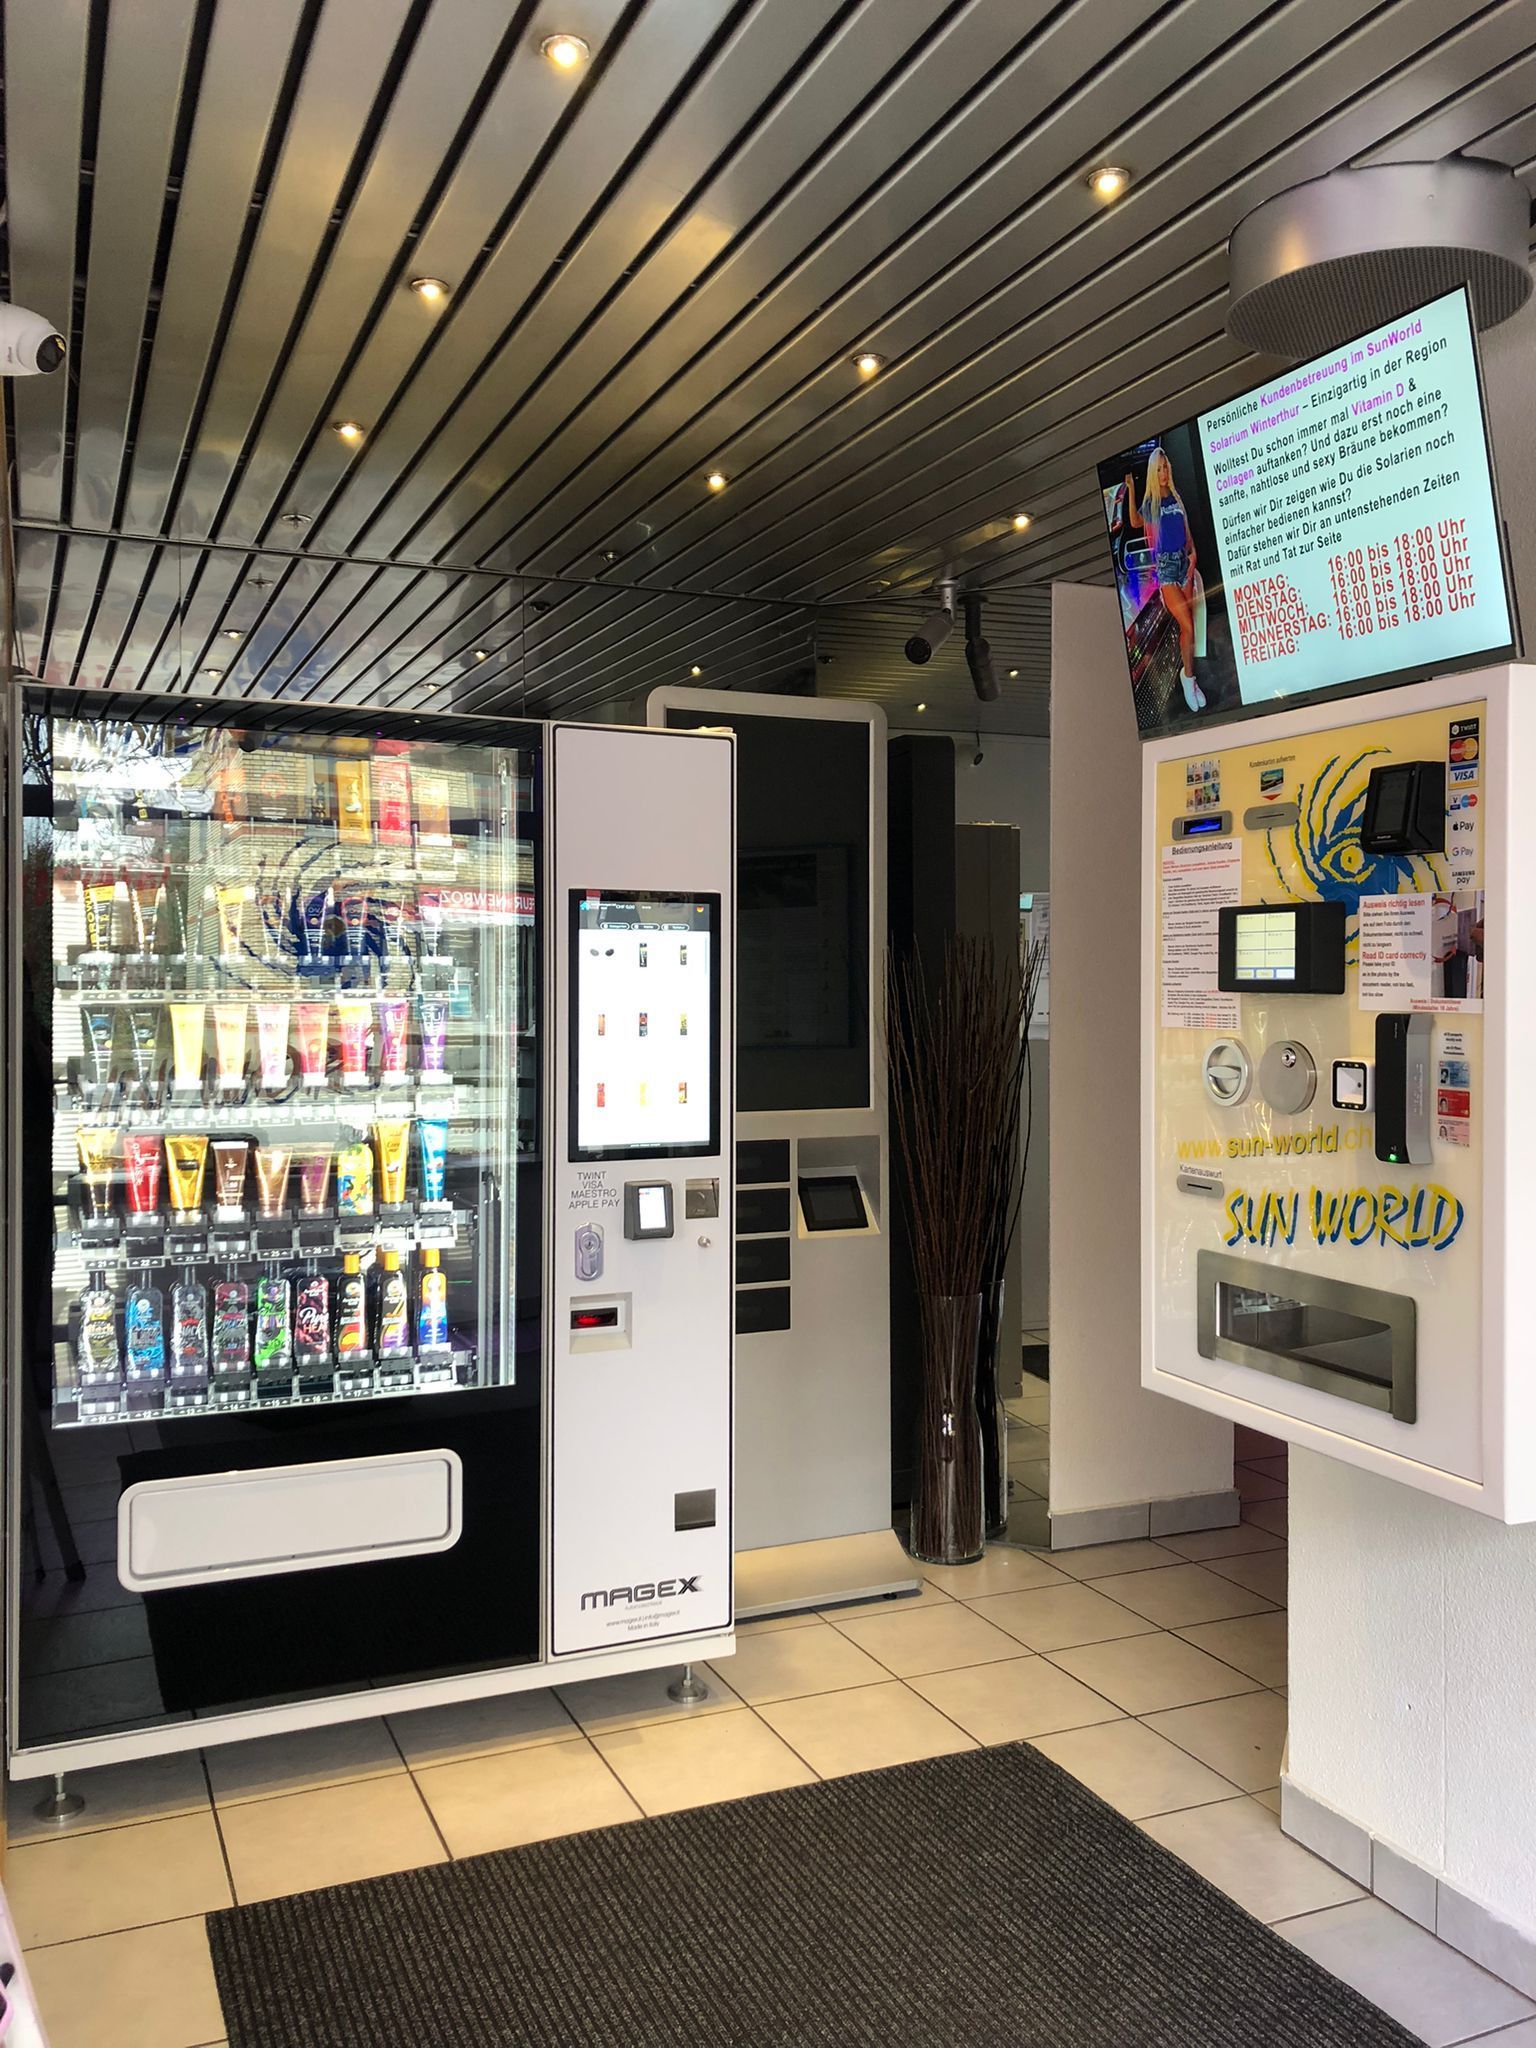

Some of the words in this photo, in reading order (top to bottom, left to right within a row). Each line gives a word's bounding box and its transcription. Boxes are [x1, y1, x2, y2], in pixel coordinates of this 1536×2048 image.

[1206, 399, 1258, 432] Persönliche
[1260, 358, 1348, 407] Kundenbetreuung
[1350, 350, 1363, 365] im
[1366, 320, 1422, 356] SunWorld
[1210, 428, 1249, 453] Solarium
[1250, 405, 1299, 435] Winterthur
[1311, 374, 1367, 408] Einzigartig
[1370, 367, 1380, 382] in
[1384, 356, 1402, 376] der
[1406, 338, 1447, 364] Region
[1213, 455, 1249, 475] Wolltest
[1251, 447, 1263, 461] Du
[1266, 434, 1294, 457] schon
[1297, 420, 1327, 443] immer
[1330, 409, 1349, 430] mal
[1351, 390, 1392, 417] Vitamin
[1396, 382, 1405, 397] D
[1408, 378, 1417, 392] &
[1216, 468, 1254, 491] Collagen
[1257, 444, 1308, 475] auftanken?
[1310, 435, 1330, 453] Und
[1333, 425, 1358, 444] dazu
[1361, 414, 1382, 434] erst
[1386, 399, 1413, 424] noch
[1417, 388, 1442, 409] eine
[1219, 489, 1249, 508] sanfte,
[1250, 470, 1290, 496] nahtlose
[1292, 462, 1310, 478] und
[1313, 454, 1336, 476] sexy
[1338, 436, 1376, 458] Bräune
[1379, 403, 1448, 443] bekommen?
[1222, 509, 1251, 530] Dürfen
[1253, 504, 1268, 518] wir
[1270, 498, 1283, 515] Dir
[1286, 483, 1317, 508] zeigen
[1320, 476, 1336, 494] wie
[1339, 471, 1354, 487] Du
[1356, 464, 1373, 480] die
[1376, 446, 1422, 471] Solarien
[1425, 430, 1455, 452] noch
[1224, 522, 1265, 546] einfacher
[1268, 506, 1310, 530] bedienen
[1312, 487, 1352, 514] kannst?
[1227, 543, 1251, 562] Dafür
[1253, 530, 1284, 553] stehen
[1286, 524, 1300, 539] wir
[1303, 518, 1317, 536] Dir
[1320, 514, 1332, 528] an
[1334, 484, 1420, 522] untenstehenden
[1423, 469, 1460, 493] Zeiten
[1230, 562, 1244, 578] mit
[1246, 556, 1261, 572] Rat
[1264, 550, 1280, 567] und
[1282, 543, 1297, 560] Tat
[1300, 540, 1314, 555] zur
[1317, 531, 1342, 549] Seite
[1234, 574, 1290, 604] MONTAG:
[1328, 548, 1363, 574] 16:00
[1368, 542, 1389, 561] bis
[1394, 526, 1432, 552] 18:00
[1438, 516, 1466, 539] Uhr
[1236, 588, 1302, 619] DIENSTAG:
[1330, 566, 1366, 590] 16:00
[1370, 560, 1392, 580] bis
[1396, 544, 1435, 570] 18:00
[1440, 535, 1468, 558] Uhr
[1238, 603, 1309, 635] MITTWOCH:
[1333, 582, 1368, 607] 16:00
[1373, 578, 1394, 596] bis
[1399, 562, 1438, 589] 18:00
[1443, 554, 1470, 576] Uhr
[1240, 612, 1332, 650] DONNERSTAG:
[1336, 600, 1371, 624] 16:00
[1376, 595, 1397, 614] bis
[1402, 581, 1440, 607] 18:00
[1446, 572, 1474, 594] Uhr
[1244, 640, 1300, 666] FREITAG:
[1338, 617, 1374, 640] 16:00
[1378, 612, 1399, 632] bis
[1404, 599, 1443, 624] 18:00
[1449, 591, 1476, 612] Uhr
[1454, 770, 1475, 782] VISA
[1172, 842, 1232, 855] Bedienungsanleitung
[1460, 821, 1474, 832] Pay
[1460, 846, 1474, 857] Pay
[1364, 900, 1387, 909] Ausweis
[1388, 900, 1407, 908] richtig
[1457, 877, 1470, 885] pay
[1362, 951, 1376, 959] Read
[1378, 951, 1384, 959] ID
[1385, 951, 1399, 959] card
[1400, 951, 1426, 960] correctly
[571, 1189, 617, 1199] MAESTRO
[577, 1171, 607, 1180] TWINT
[582, 1181, 604, 1189] VISA
[1180, 1164, 1222, 1179] Kartenauswurf
[569, 1200, 599, 1209] APPLE
[601, 1199, 620, 1208] PAY
[1223, 1186, 1299, 1248] SUN
[1309, 1184, 1465, 1251] WORLD
[580, 1575, 702, 1611] MAGEX
